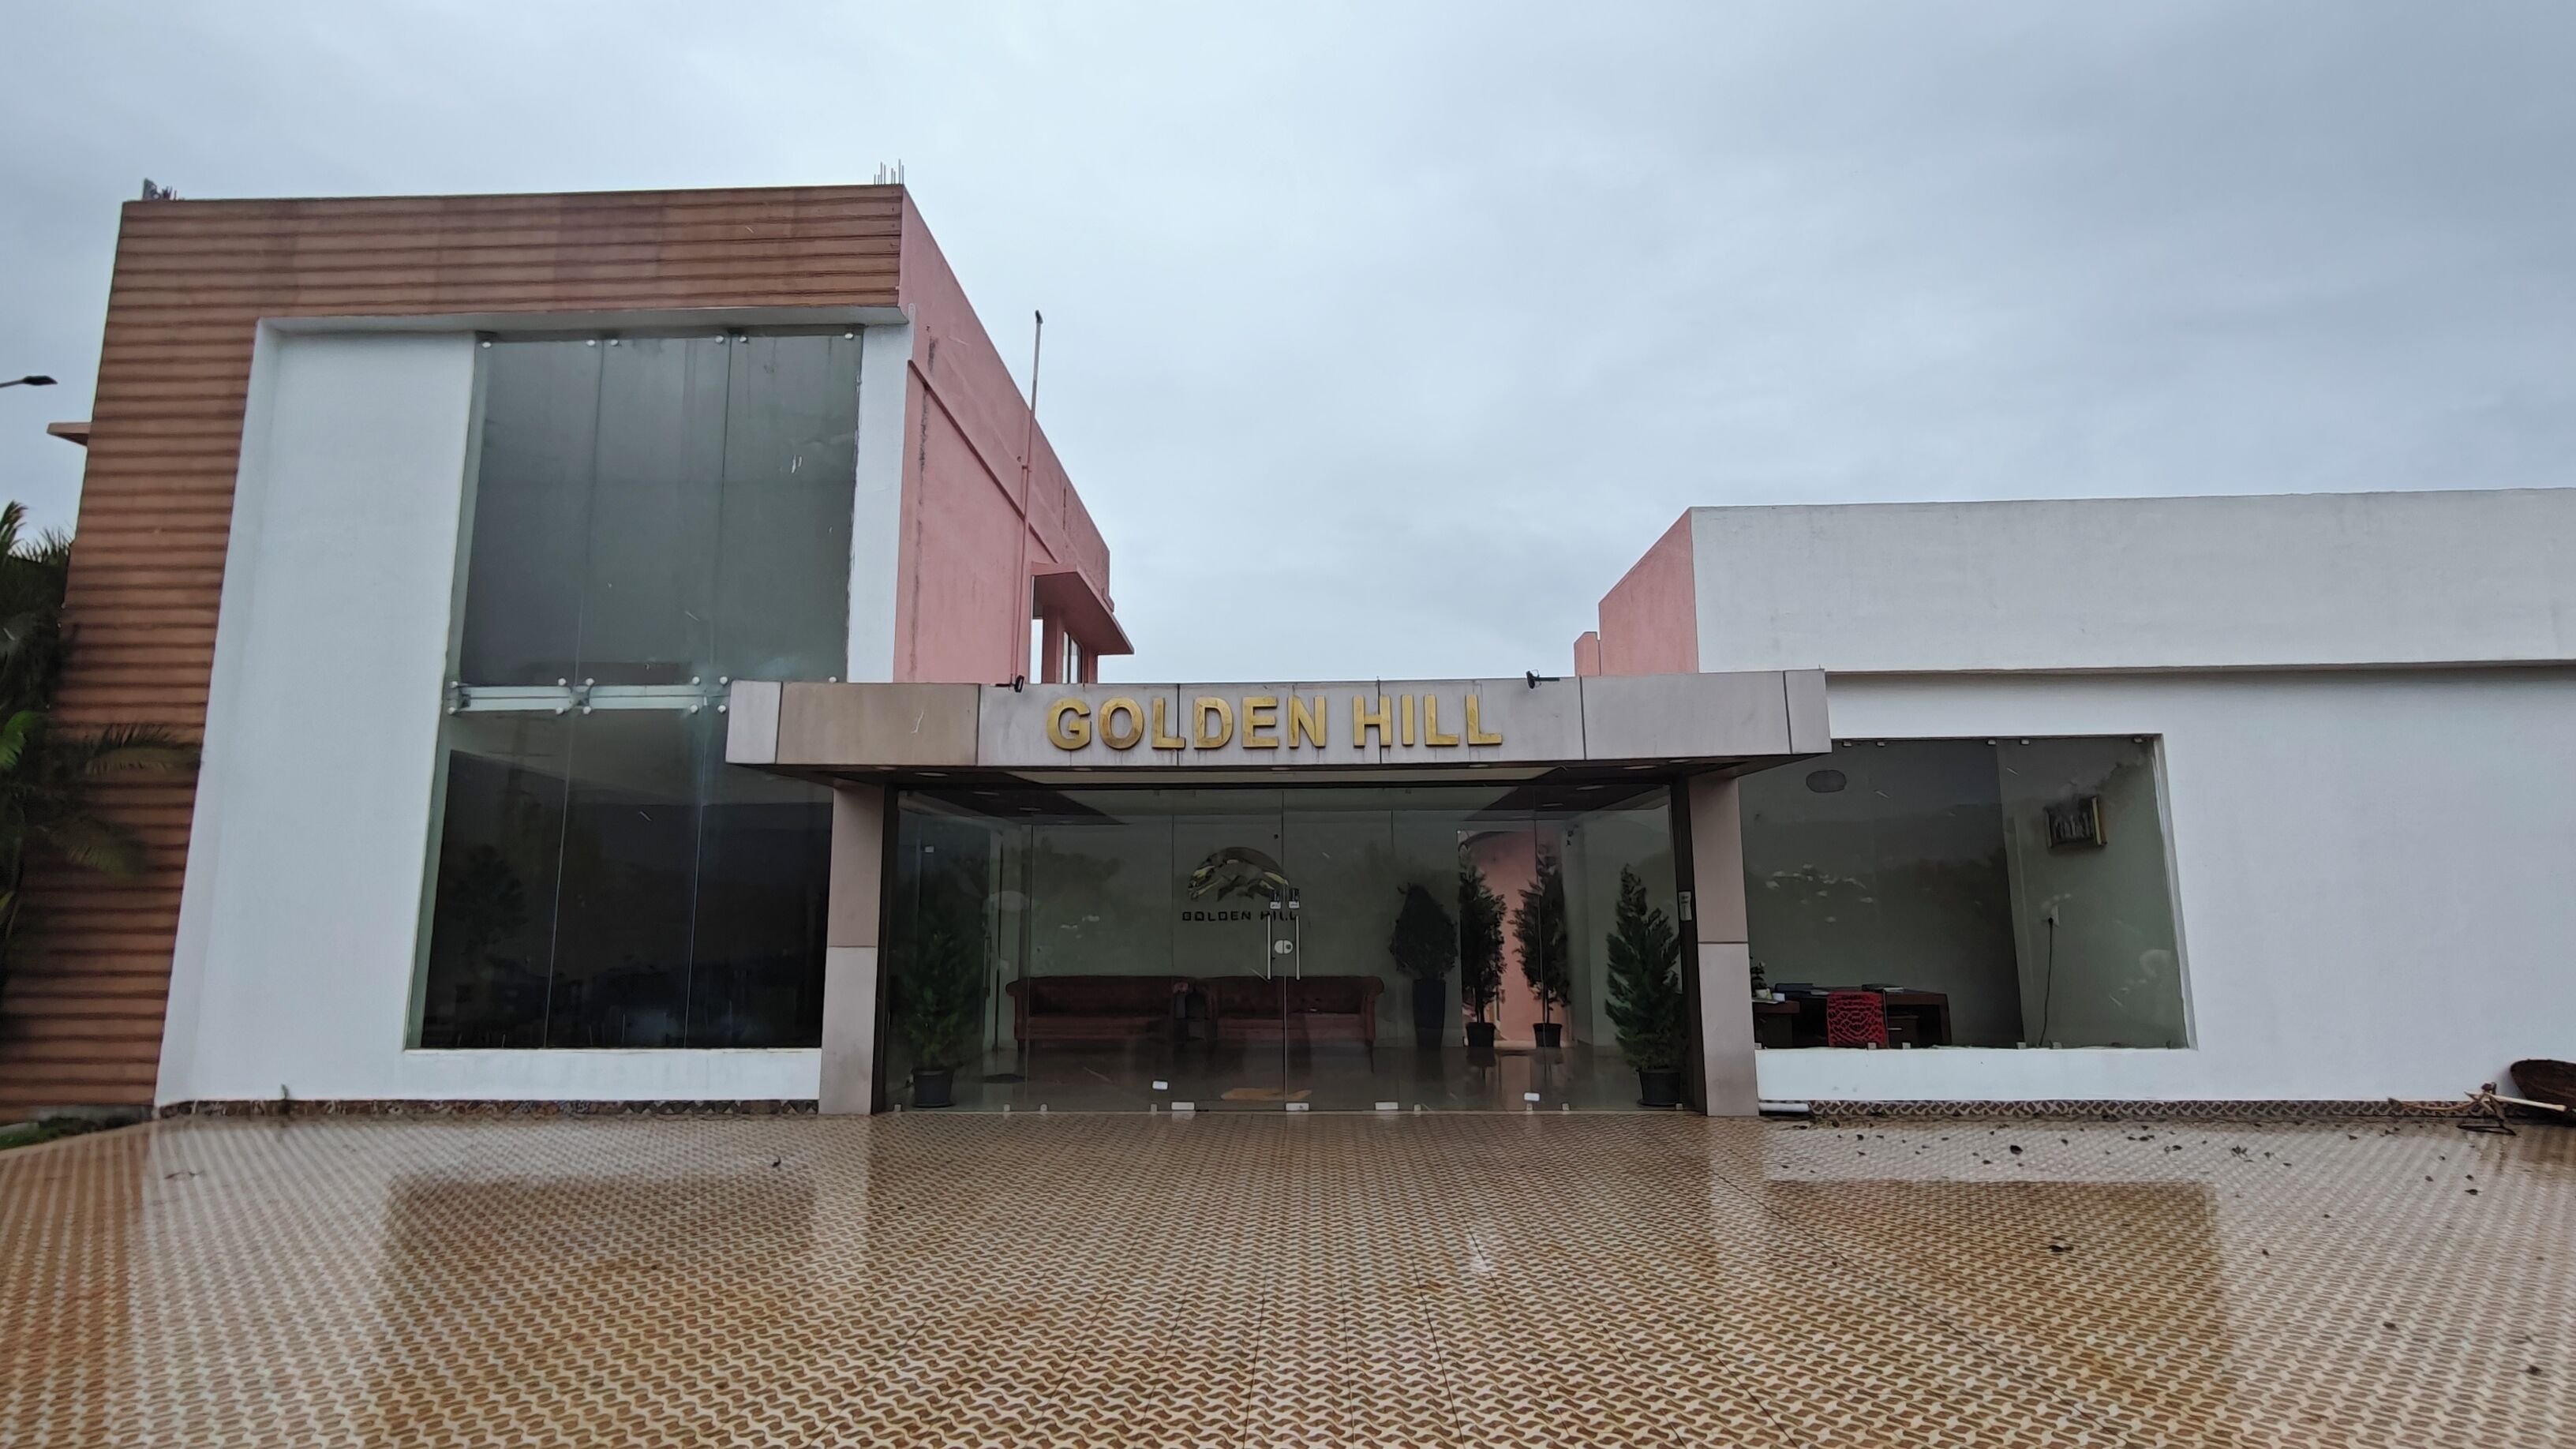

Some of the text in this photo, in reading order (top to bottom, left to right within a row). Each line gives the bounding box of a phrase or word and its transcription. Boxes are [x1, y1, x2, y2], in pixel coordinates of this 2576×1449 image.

[1046, 693, 1503, 751] GOLDEN HILL
[1181, 910, 1252, 922] GOLDEN
